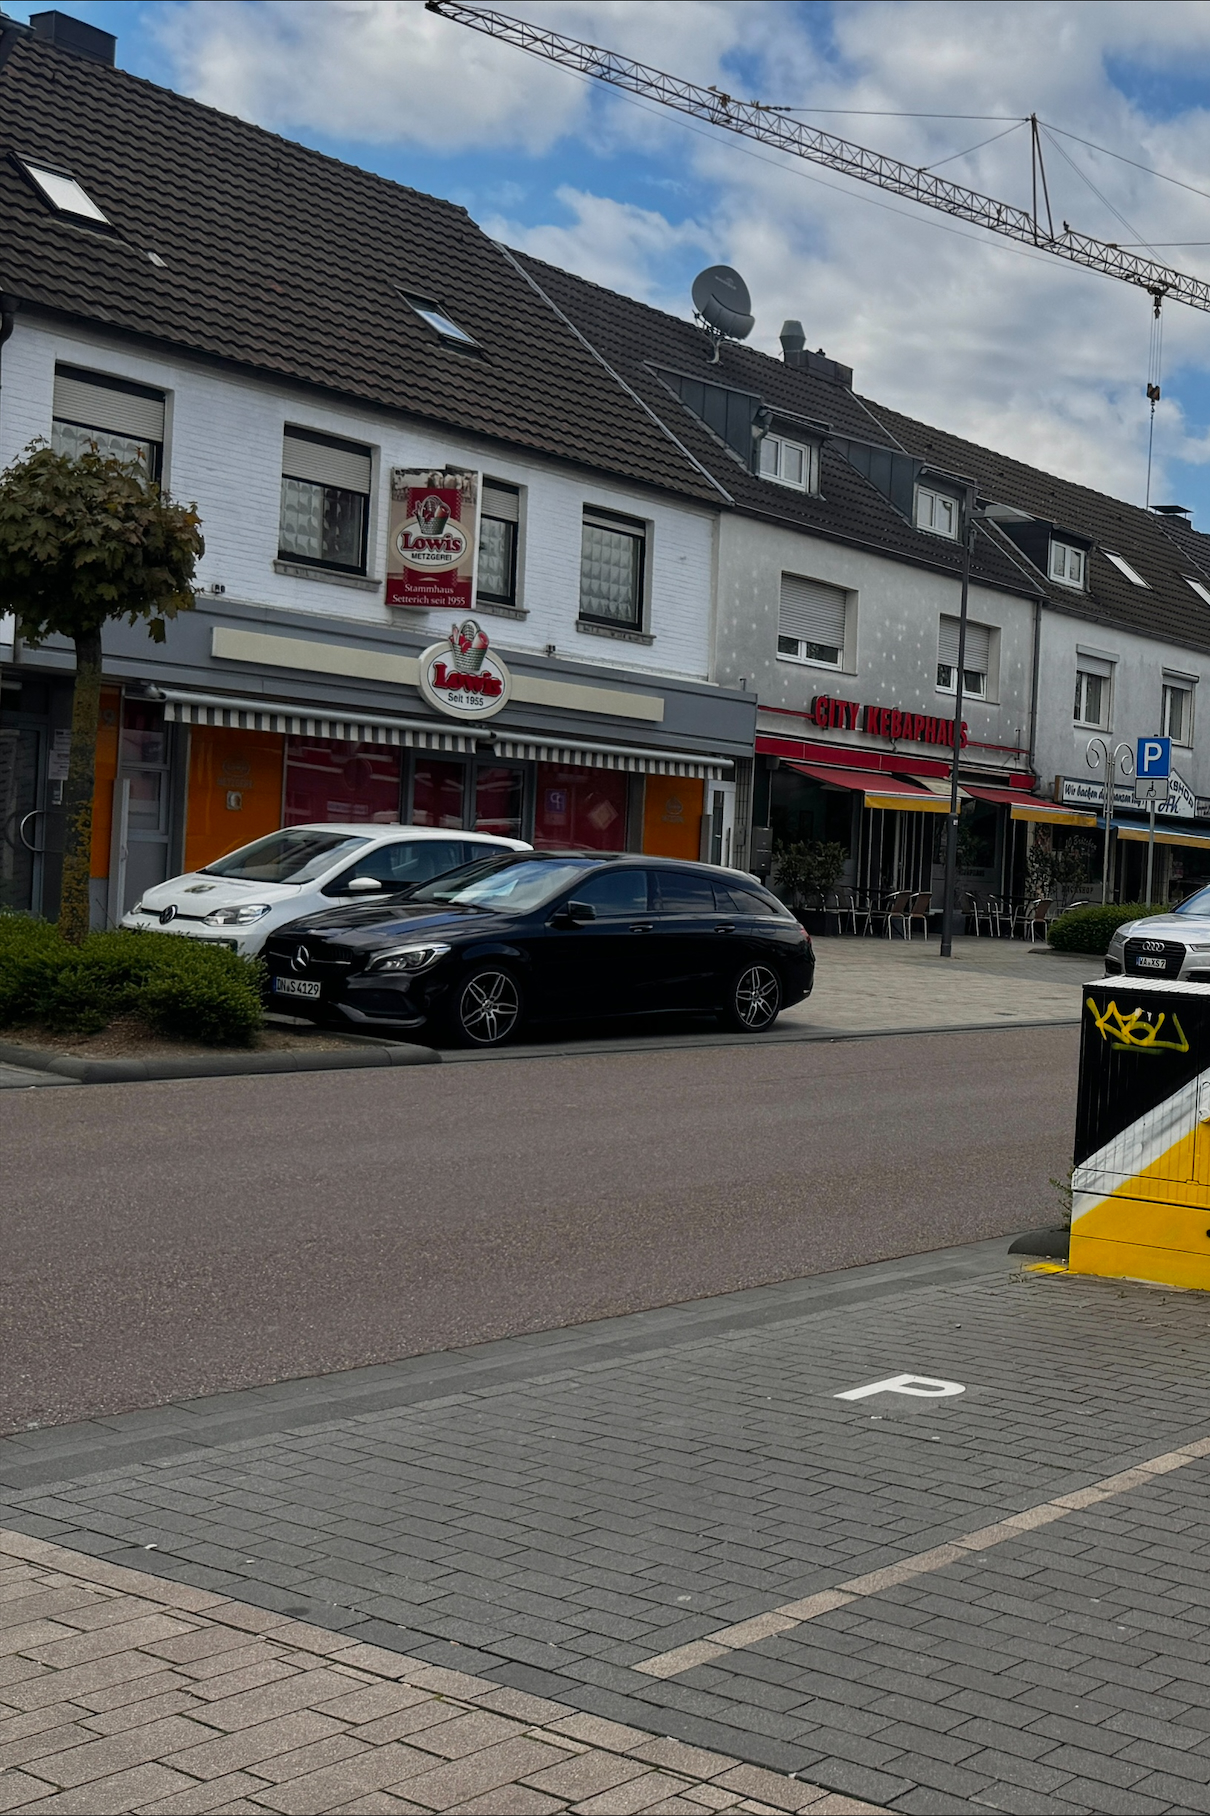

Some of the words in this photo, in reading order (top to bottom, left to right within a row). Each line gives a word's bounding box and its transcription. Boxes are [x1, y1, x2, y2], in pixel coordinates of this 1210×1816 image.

[400, 531, 462, 553] Lowis
[411, 553, 452, 561] METZGEREI
[404, 584, 454, 594] Stammhaus
[392, 594, 430, 605] Setterich
[430, 596, 446, 605] seit
[448, 596, 466, 606] 1955
[432, 661, 503, 697] Lowis
[447, 692, 464, 704] Seit
[466, 696, 484, 706] 1955
[812, 695, 860, 731] CITY
[1144, 742, 1163, 772] P
[1064, 783, 1076, 795] Wir
[1077, 785, 1098, 800] backen
[1112, 793, 1131, 804] anzen
[297, 982, 319, 996] 4129
[833, 1374, 966, 1400] P
